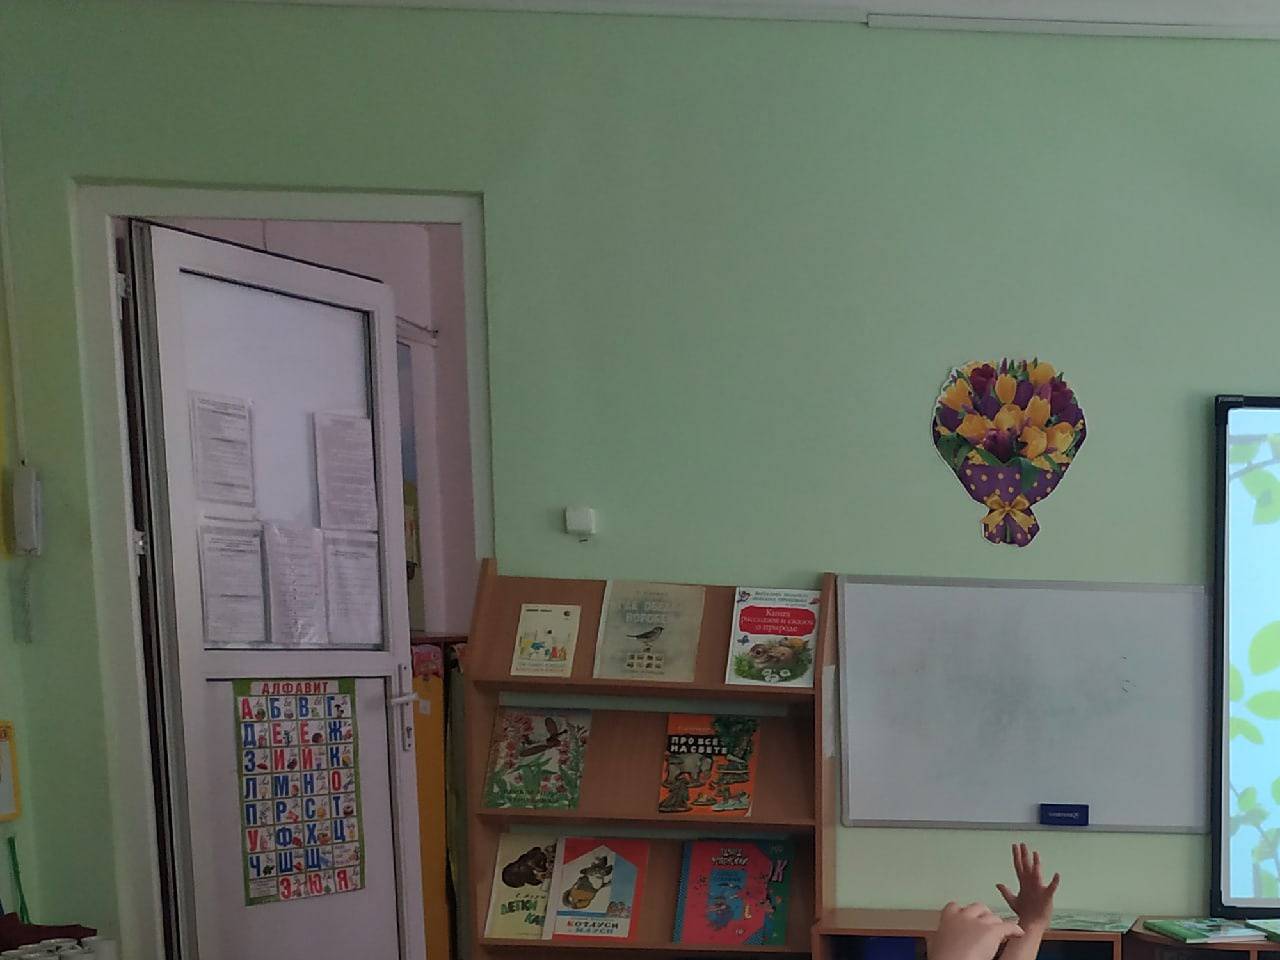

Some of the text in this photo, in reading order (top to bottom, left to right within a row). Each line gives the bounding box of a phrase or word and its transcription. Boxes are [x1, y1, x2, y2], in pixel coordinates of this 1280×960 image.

[766, 609, 791, 617] Книга
[262, 681, 329, 695] АЛФАВИТ
[242, 698, 253, 719] А
[270, 697, 281, 719] Б
[299, 696, 309, 717] В
[327, 696, 335, 717] Г
[243, 723, 257, 748] Д
[272, 723, 282, 744] Е
[328, 720, 343, 742] Ж
[671, 736, 695, 745] ПРО
[244, 750, 256, 772] З
[274, 749, 285, 770] И
[670, 745, 728, 754] НА СВЕТЕ
[245, 778, 257, 799] Л
[274, 775, 289, 796] М
[303, 773, 314, 794] Н
[332, 771, 341, 791] О
[245, 796, 341, 825] П Р С Т
[247, 820, 345, 851] У Ф Х Ц
[249, 855, 260, 877] Ч
[279, 851, 293, 873] Ш
[306, 848, 321, 869] Щ
[280, 877, 291, 899] Э
[308, 873, 323, 894] Ю
[336, 869, 349, 891] Я
[500, 899, 538, 915] ДЕТКИ
